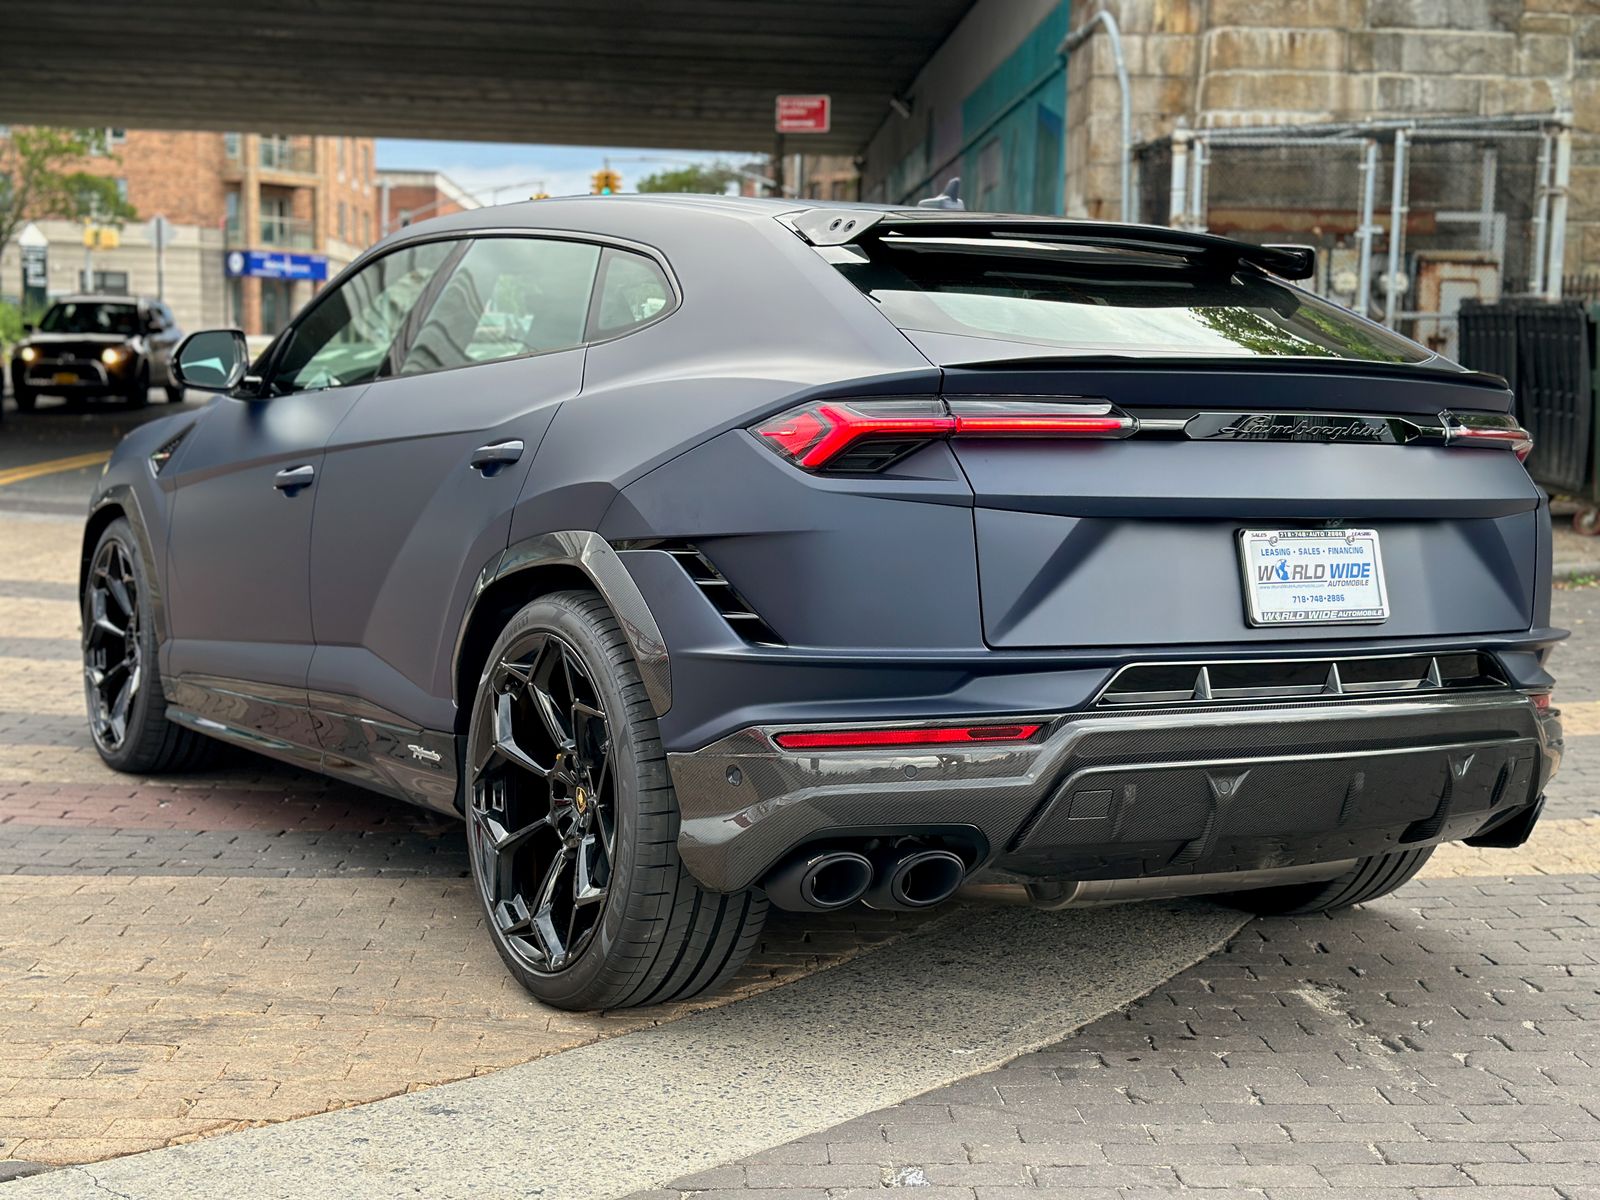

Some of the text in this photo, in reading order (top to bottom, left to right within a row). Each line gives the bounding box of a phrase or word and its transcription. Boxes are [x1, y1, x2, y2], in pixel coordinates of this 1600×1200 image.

[1219, 414, 1389, 439] Lamborghini
[1261, 546, 1364, 556] LEASING SALES FINANCING
[1329, 562, 1371, 579] WIDE
[1327, 579, 1369, 587] AUTOMOBILE
[1308, 609, 1339, 620] WIDE
[1337, 608, 1383, 617] AUTOMOBILE
